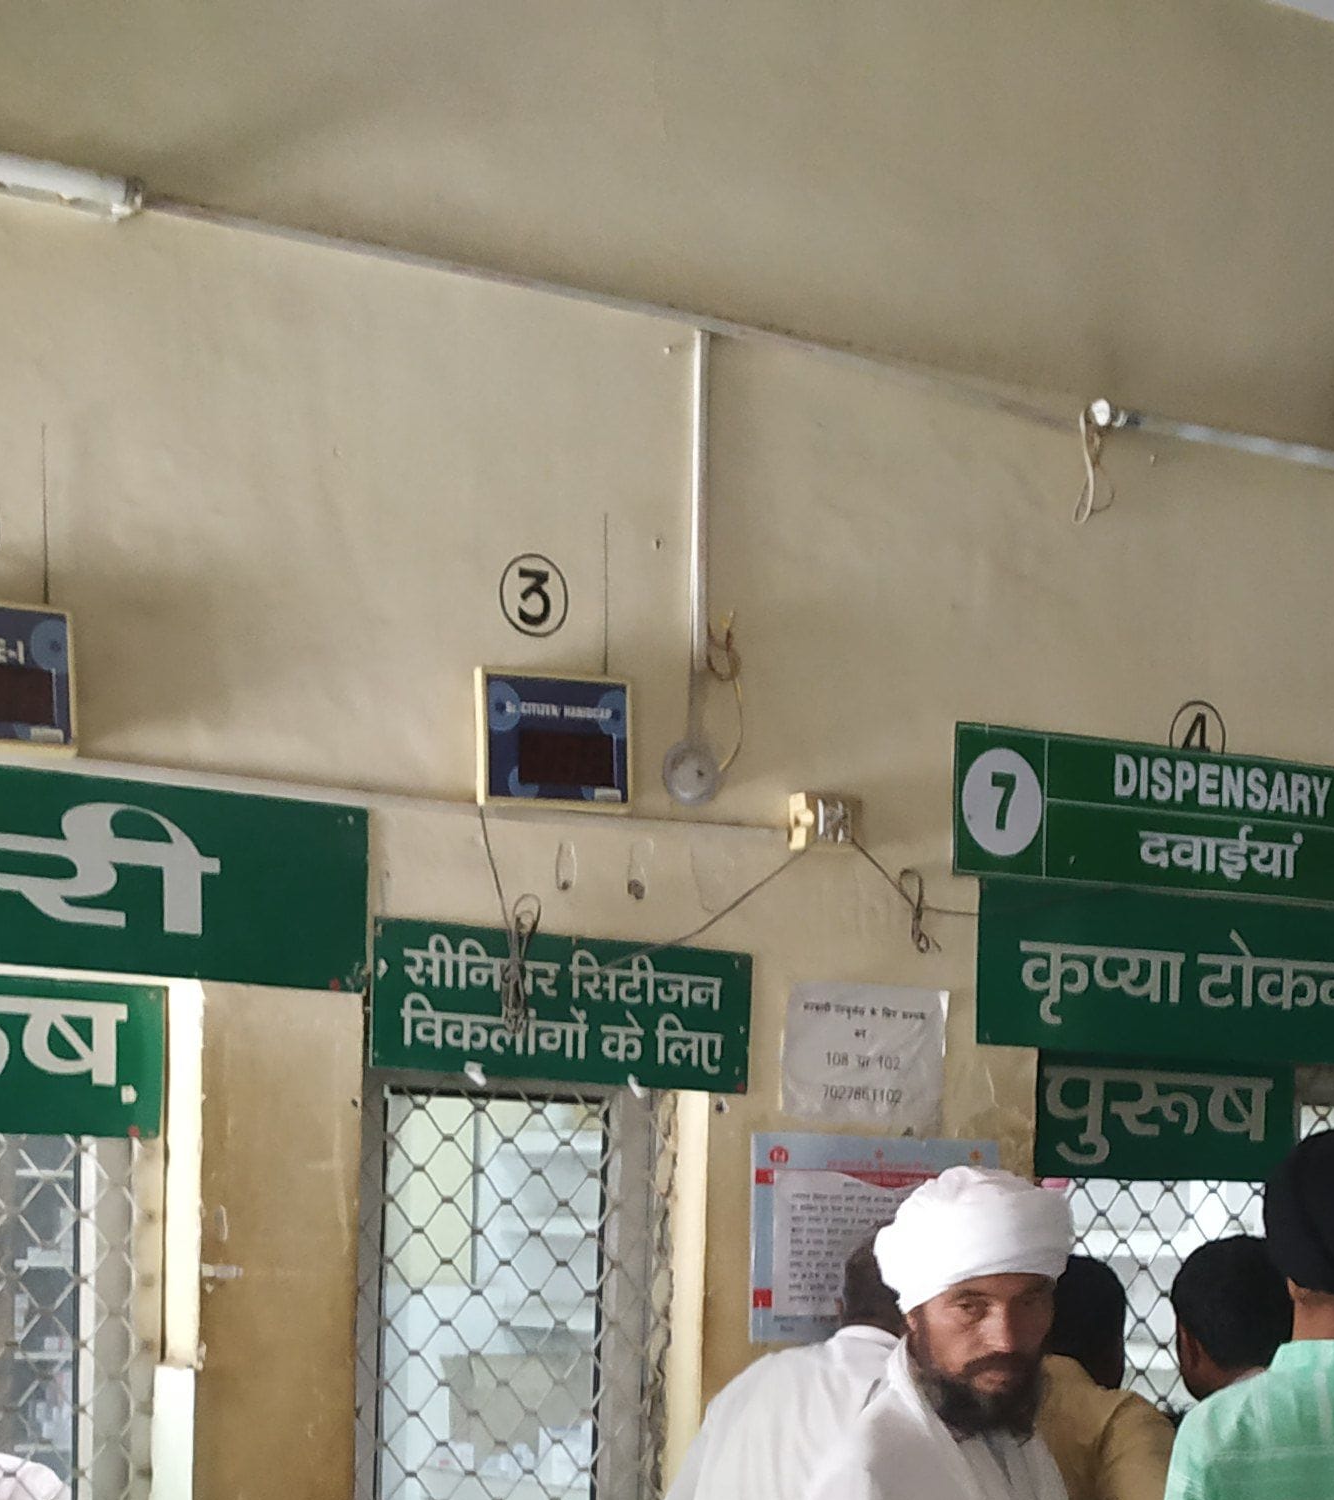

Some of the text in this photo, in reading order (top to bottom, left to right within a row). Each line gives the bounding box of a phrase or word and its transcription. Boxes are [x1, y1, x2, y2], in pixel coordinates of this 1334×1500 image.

[518, 566, 550, 626] 3
[1182, 713, 1210, 753] 4
[991, 772, 1017, 830] 7
[1114, 753, 1333, 818] DISPENSARY
[1139, 825, 1304, 882] दवाईयां
[568, 949, 723, 1012] सिटीजन
[1019, 940, 1186, 1026] कृप्या
[400, 991, 723, 1074] विकलांगों के लिए
[825, 1050, 849, 1067] 108
[877, 1054, 901, 1071] 102
[1042, 1065, 1274, 1166] पुरूष
